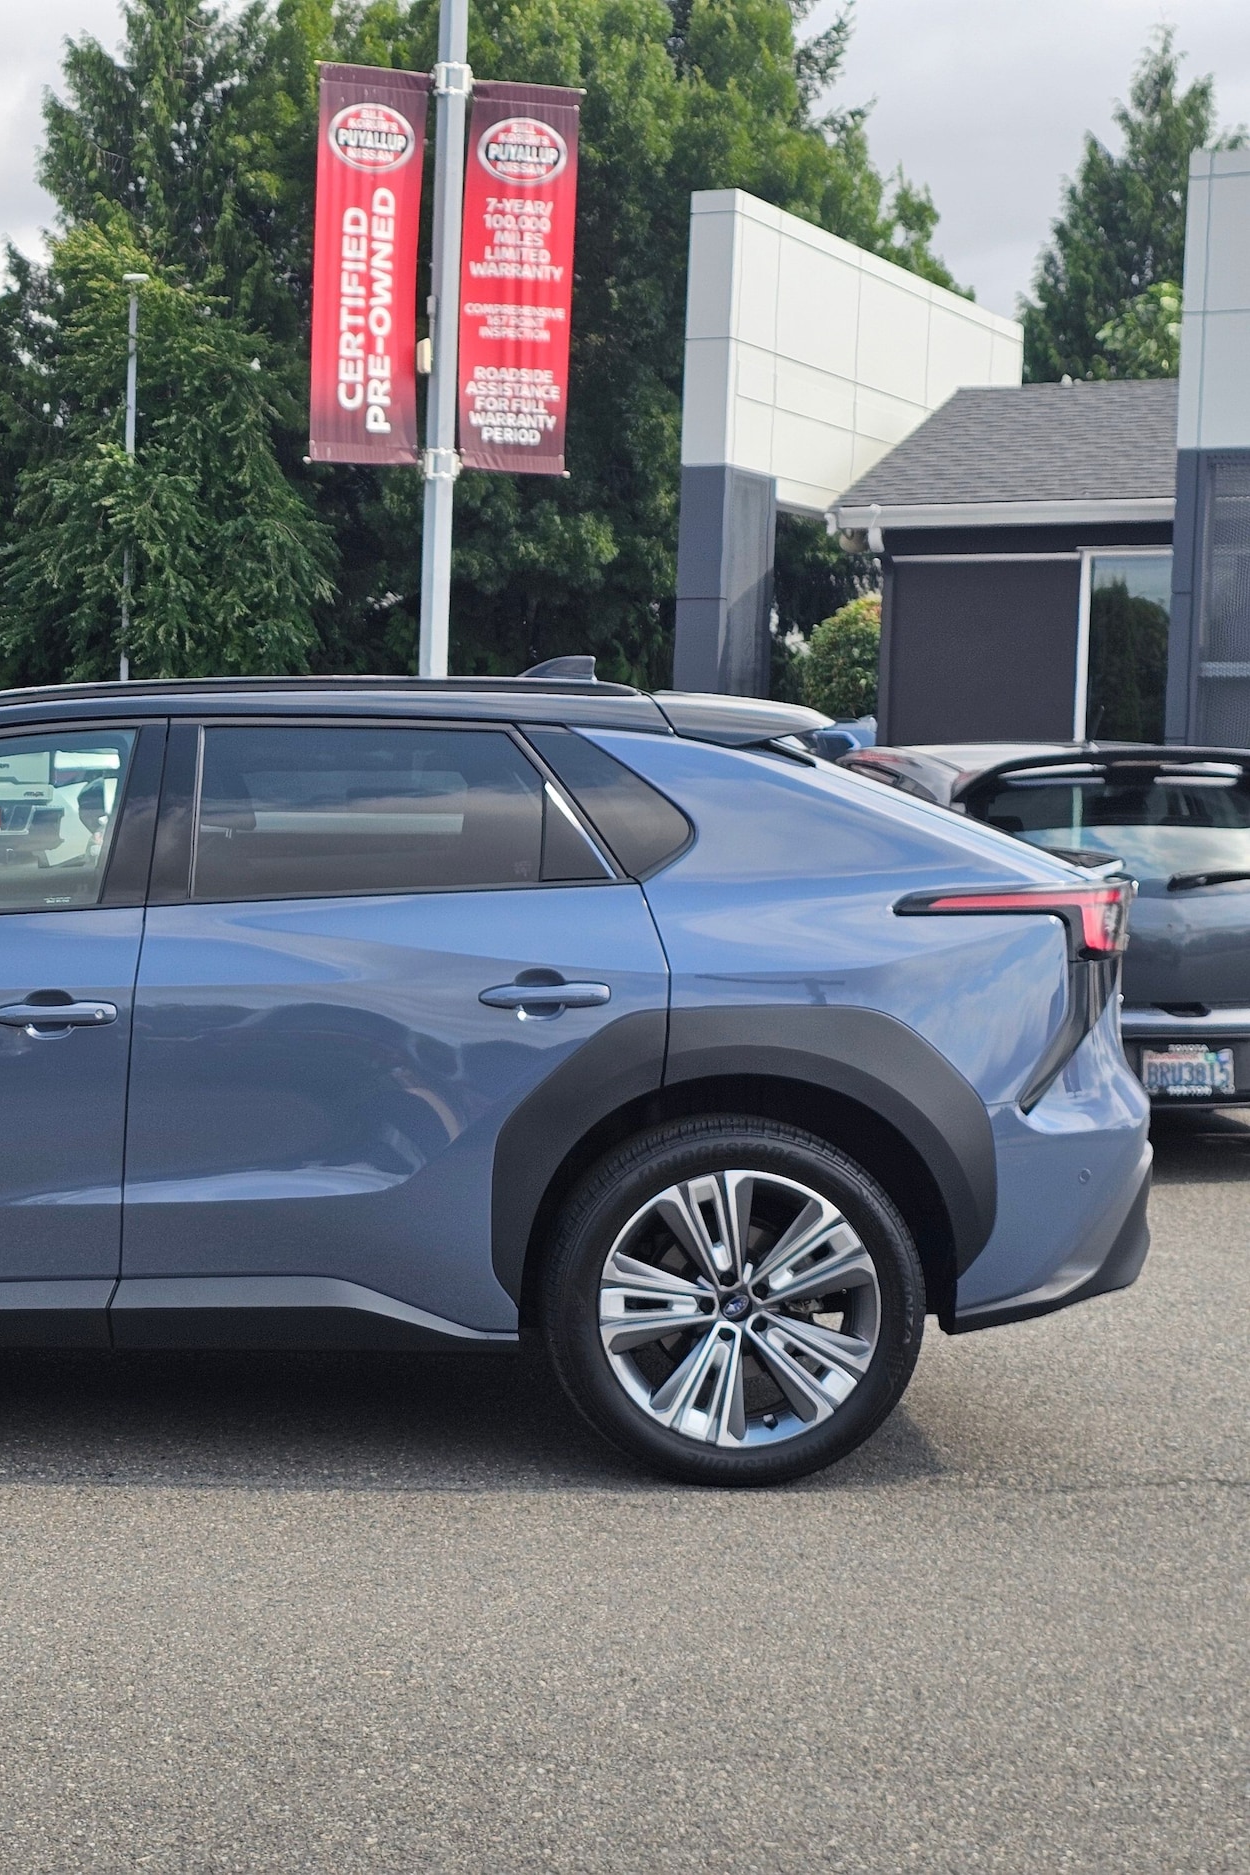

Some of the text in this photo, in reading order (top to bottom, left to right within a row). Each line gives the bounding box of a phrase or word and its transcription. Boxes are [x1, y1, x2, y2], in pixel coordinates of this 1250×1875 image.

[360, 108, 386, 120] BILL
[338, 128, 406, 151] PUYALLUP
[346, 147, 394, 162] NISSAN
[489, 143, 558, 164] PUYALLUP
[497, 162, 546, 175] NISSAN
[486, 198, 554, 217] 7-YEAR/
[493, 231, 544, 247] MILES
[484, 246, 551, 264] LIMITED
[469, 261, 563, 282] WARRANTY
[337, 206, 368, 410] CERTIFIED
[366, 187, 396, 434] PRE-OWNED
[464, 303, 566, 321] COMPREHENSIVE
[478, 326, 551, 342] INSPECTION
[474, 366, 554, 384] ROADSIDE
[465, 381, 560, 402] ASSISTANCE
[474, 396, 548, 413] FOR FULL
[469, 411, 557, 432] WARRANTY
[481, 426, 540, 446] PERIOD
